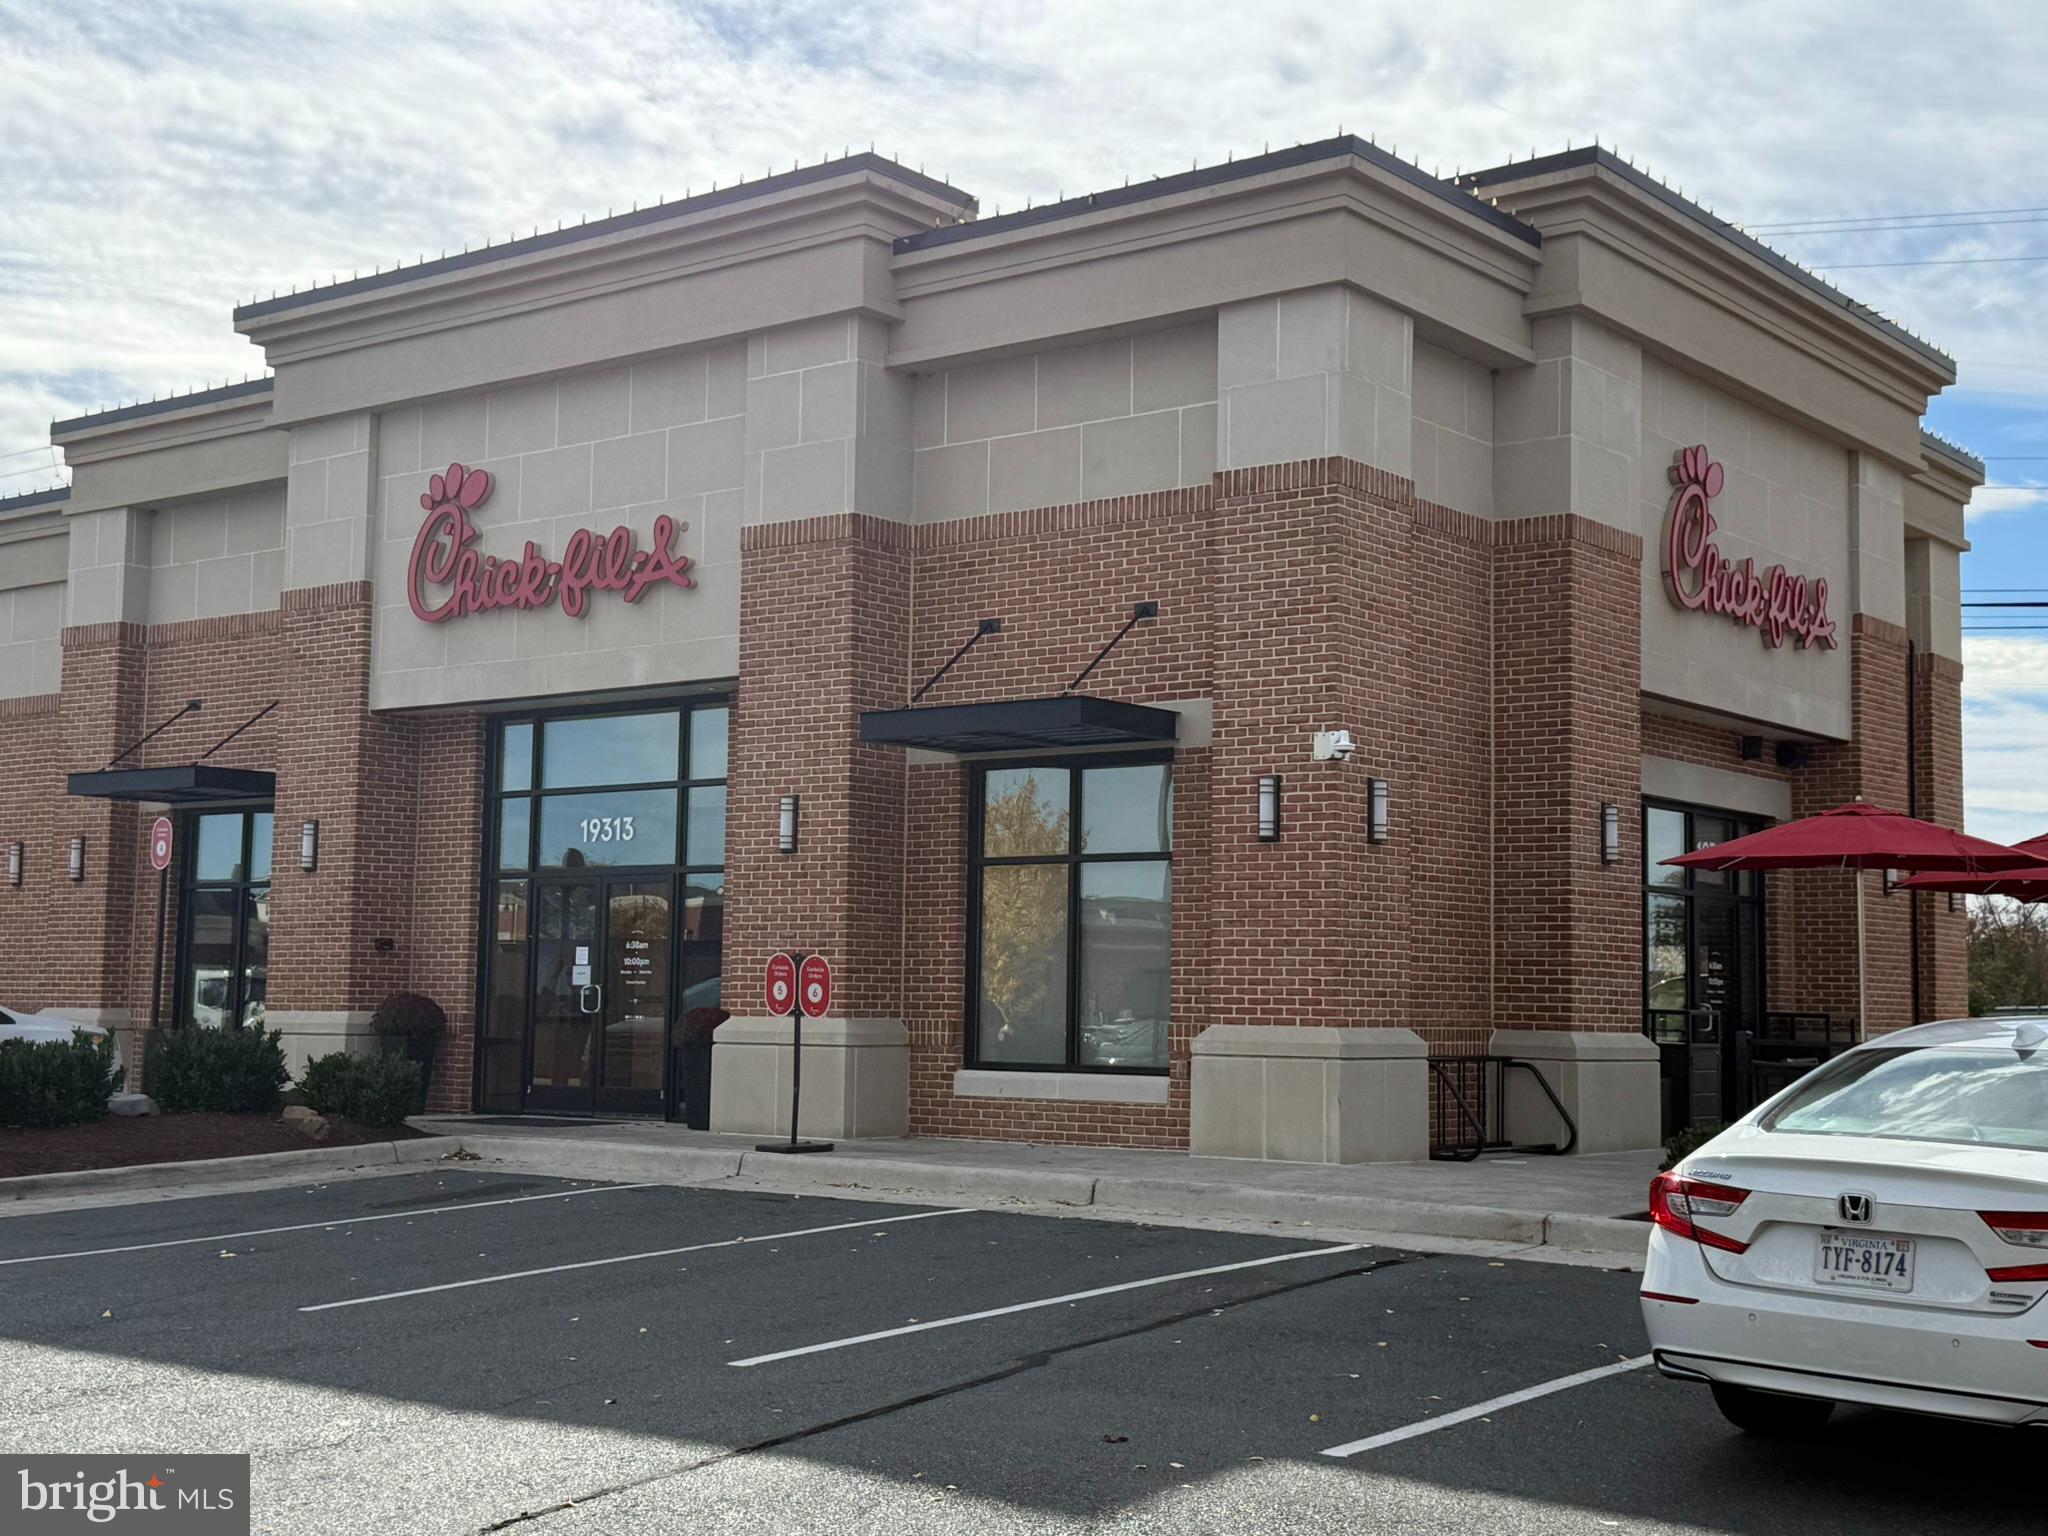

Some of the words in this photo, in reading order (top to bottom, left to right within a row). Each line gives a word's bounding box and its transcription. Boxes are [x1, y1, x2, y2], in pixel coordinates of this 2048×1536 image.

[407, 495, 695, 623] Chick-fil-A
[1663, 480, 1838, 650] Chick-fil-A
[580, 816, 634, 843] 19313
[625, 940, 649, 949] 6:30am
[623, 957, 651, 967] 10:00pm
[777, 985, 783, 995] 5
[812, 987, 819, 998] 6
[1841, 1237, 1888, 1251] VIRGINIA
[1822, 1245, 1907, 1277] TYF-8174
